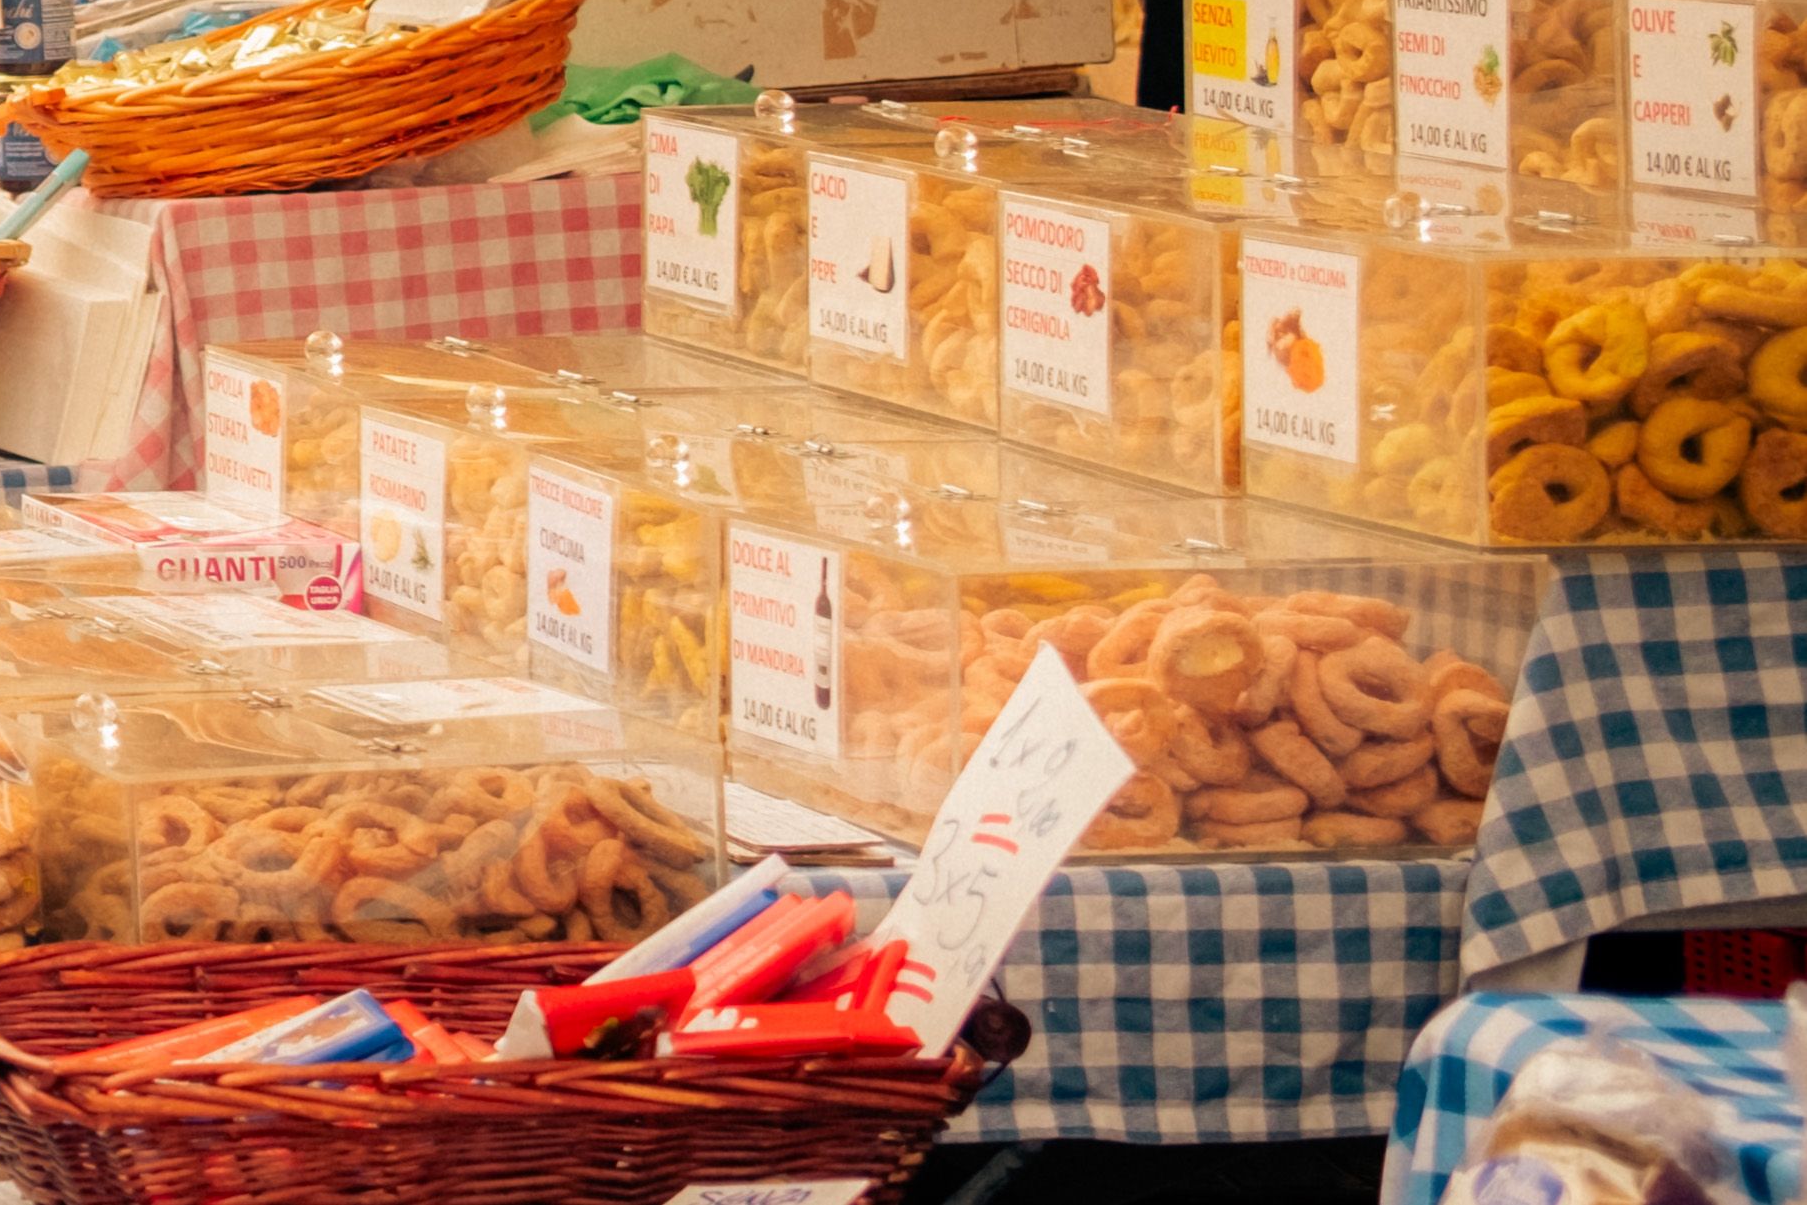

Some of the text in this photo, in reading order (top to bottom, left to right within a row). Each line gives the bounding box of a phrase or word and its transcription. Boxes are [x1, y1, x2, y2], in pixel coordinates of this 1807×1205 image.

[1193, 2, 1234, 28] SENZA
[1632, 8, 1675, 34] OLIVE
[1193, 42, 1237, 67] LIEVITO
[1398, 32, 1445, 56] SEMI DI
[1633, 54, 1642, 78] E
[1399, 74, 1461, 100] FINOCCHIO
[1203, 88, 1274, 119] 14,00 € AL KG
[1634, 101, 1691, 126] CAPPERI
[1410, 123, 1487, 154] 14,00 € AL KG
[1647, 152, 1732, 182] 14,00 € AL KG
[649, 172, 660, 194] DI
[811, 172, 847, 200] CACIO
[649, 214, 677, 237] RAPA
[811, 216, 819, 239] E
[1006, 212, 1085, 252] POMODORO
[811, 258, 837, 284] PEPE
[1006, 259, 1063, 295] SECCO DI
[1245, 256, 1287, 280] ZENZERO
[1297, 264, 1347, 290] CURCUMA
[1006, 305, 1071, 341] CERIGNOLA
[1015, 357, 1087, 397] 14,00 € AL KG
[1256, 407, 1336, 445] 14,00 € AL KG
[372, 430, 417, 465] PATATE E
[370, 473, 427, 512] ROSMARINO
[540, 527, 585, 565] CURCUMA
[732, 540, 791, 577] DOLCE AL
[279, 556, 306, 569] 500
[733, 590, 797, 628] PRIMITIVO
[733, 638, 805, 677] DI MANDURIA
[743, 697, 817, 741] 14,00 € AL KG
